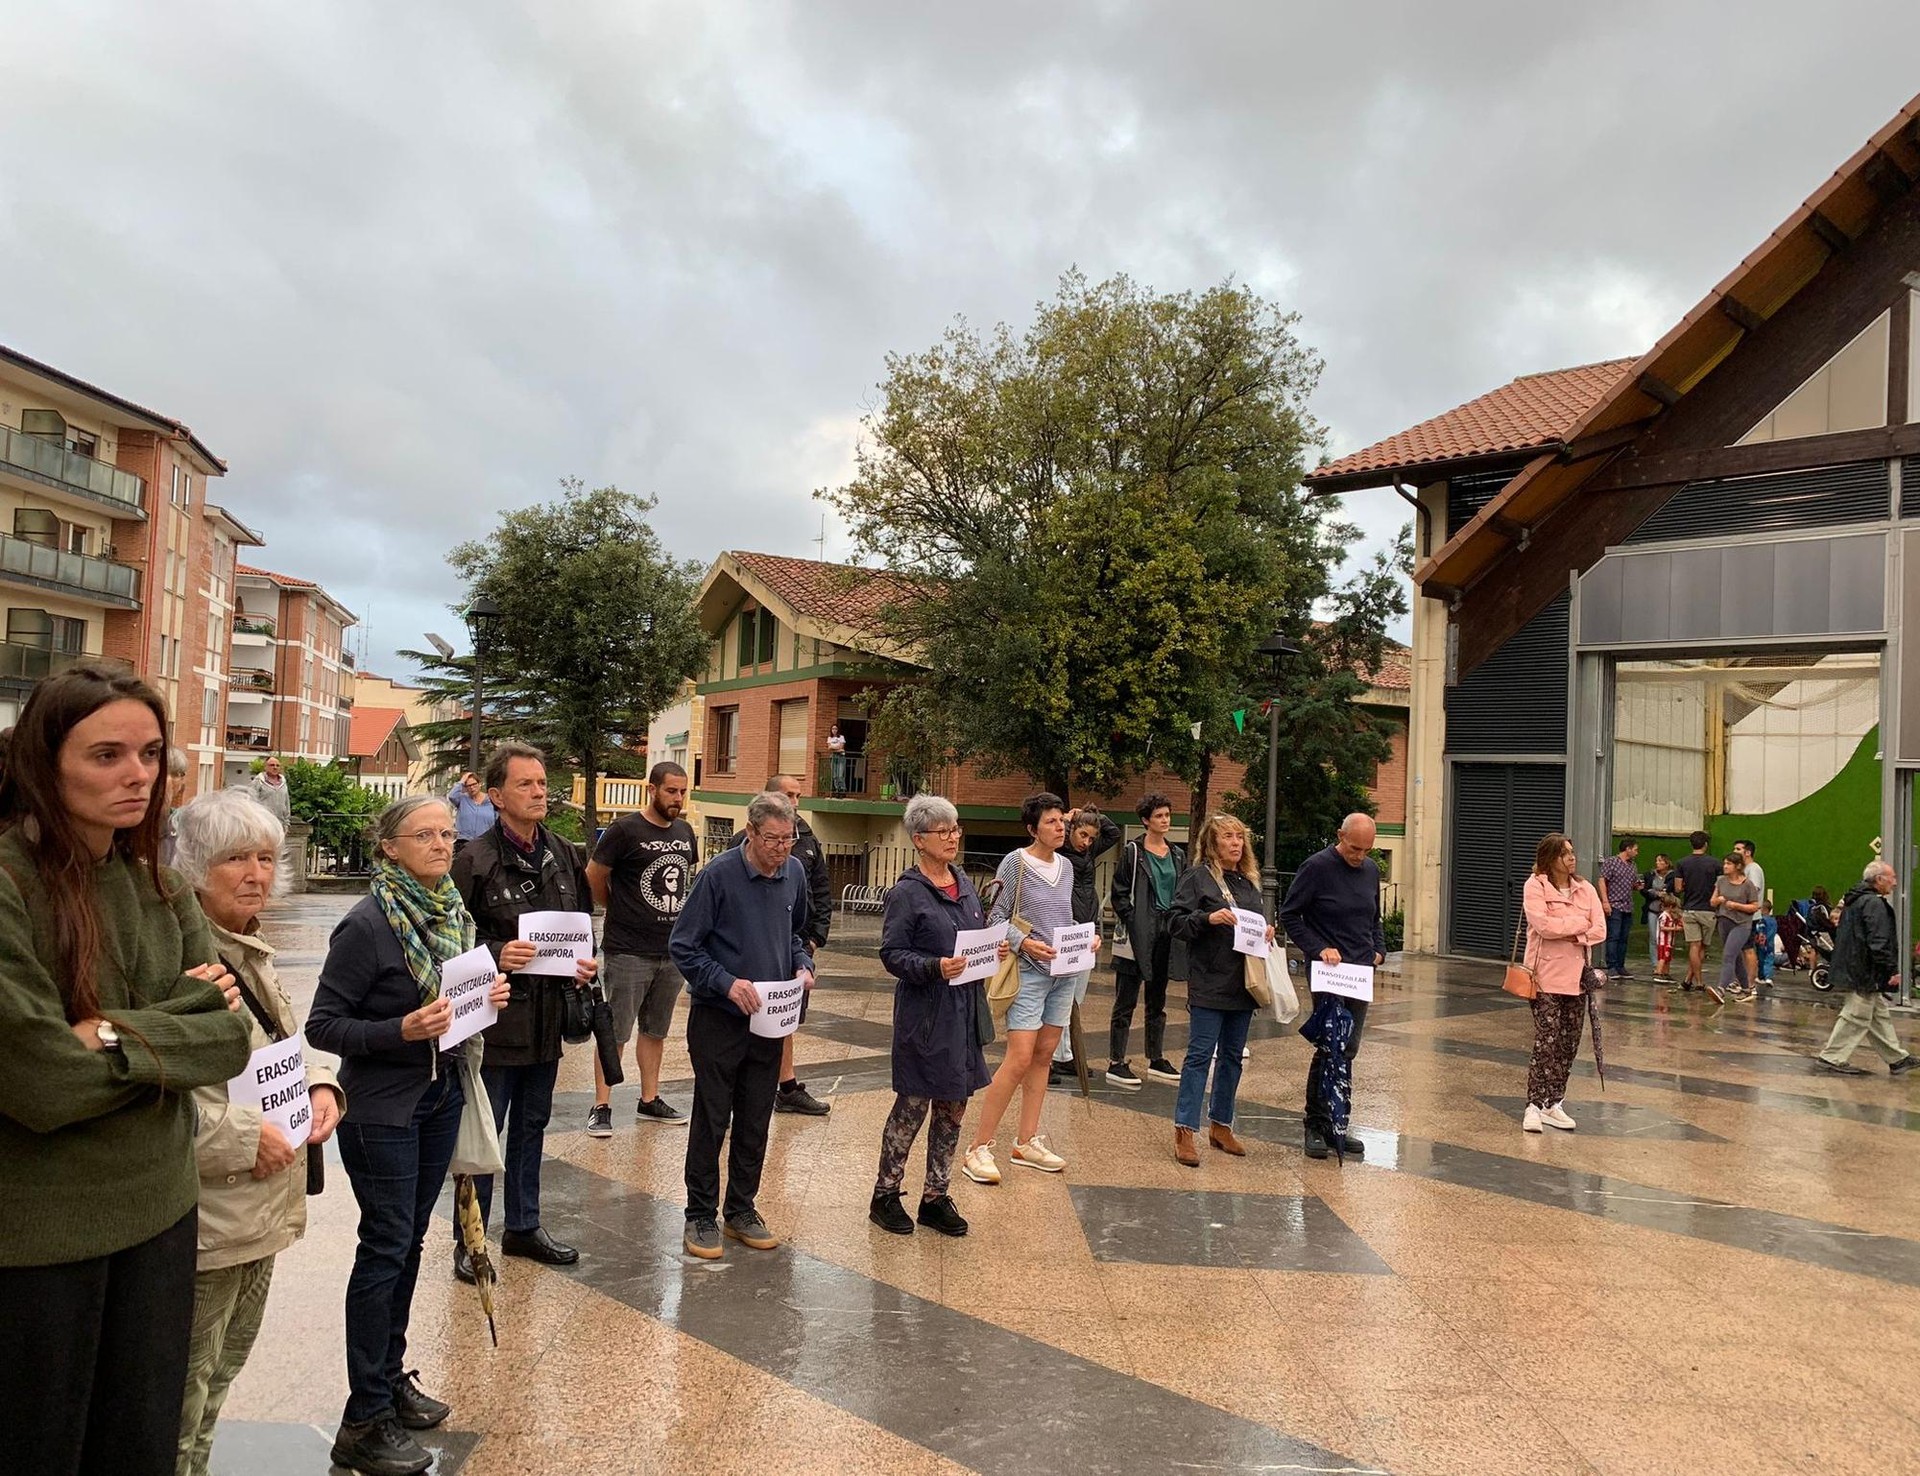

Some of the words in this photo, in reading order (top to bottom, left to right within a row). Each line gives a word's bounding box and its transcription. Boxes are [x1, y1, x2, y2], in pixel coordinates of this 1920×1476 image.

[529, 932, 590, 943] ERASOTZAILEAK
[537, 948, 574, 958] KANPORA
[967, 954, 995, 968] KANPORA
[454, 995, 484, 1020] KANPORA
[289, 1105, 310, 1130] GABE
